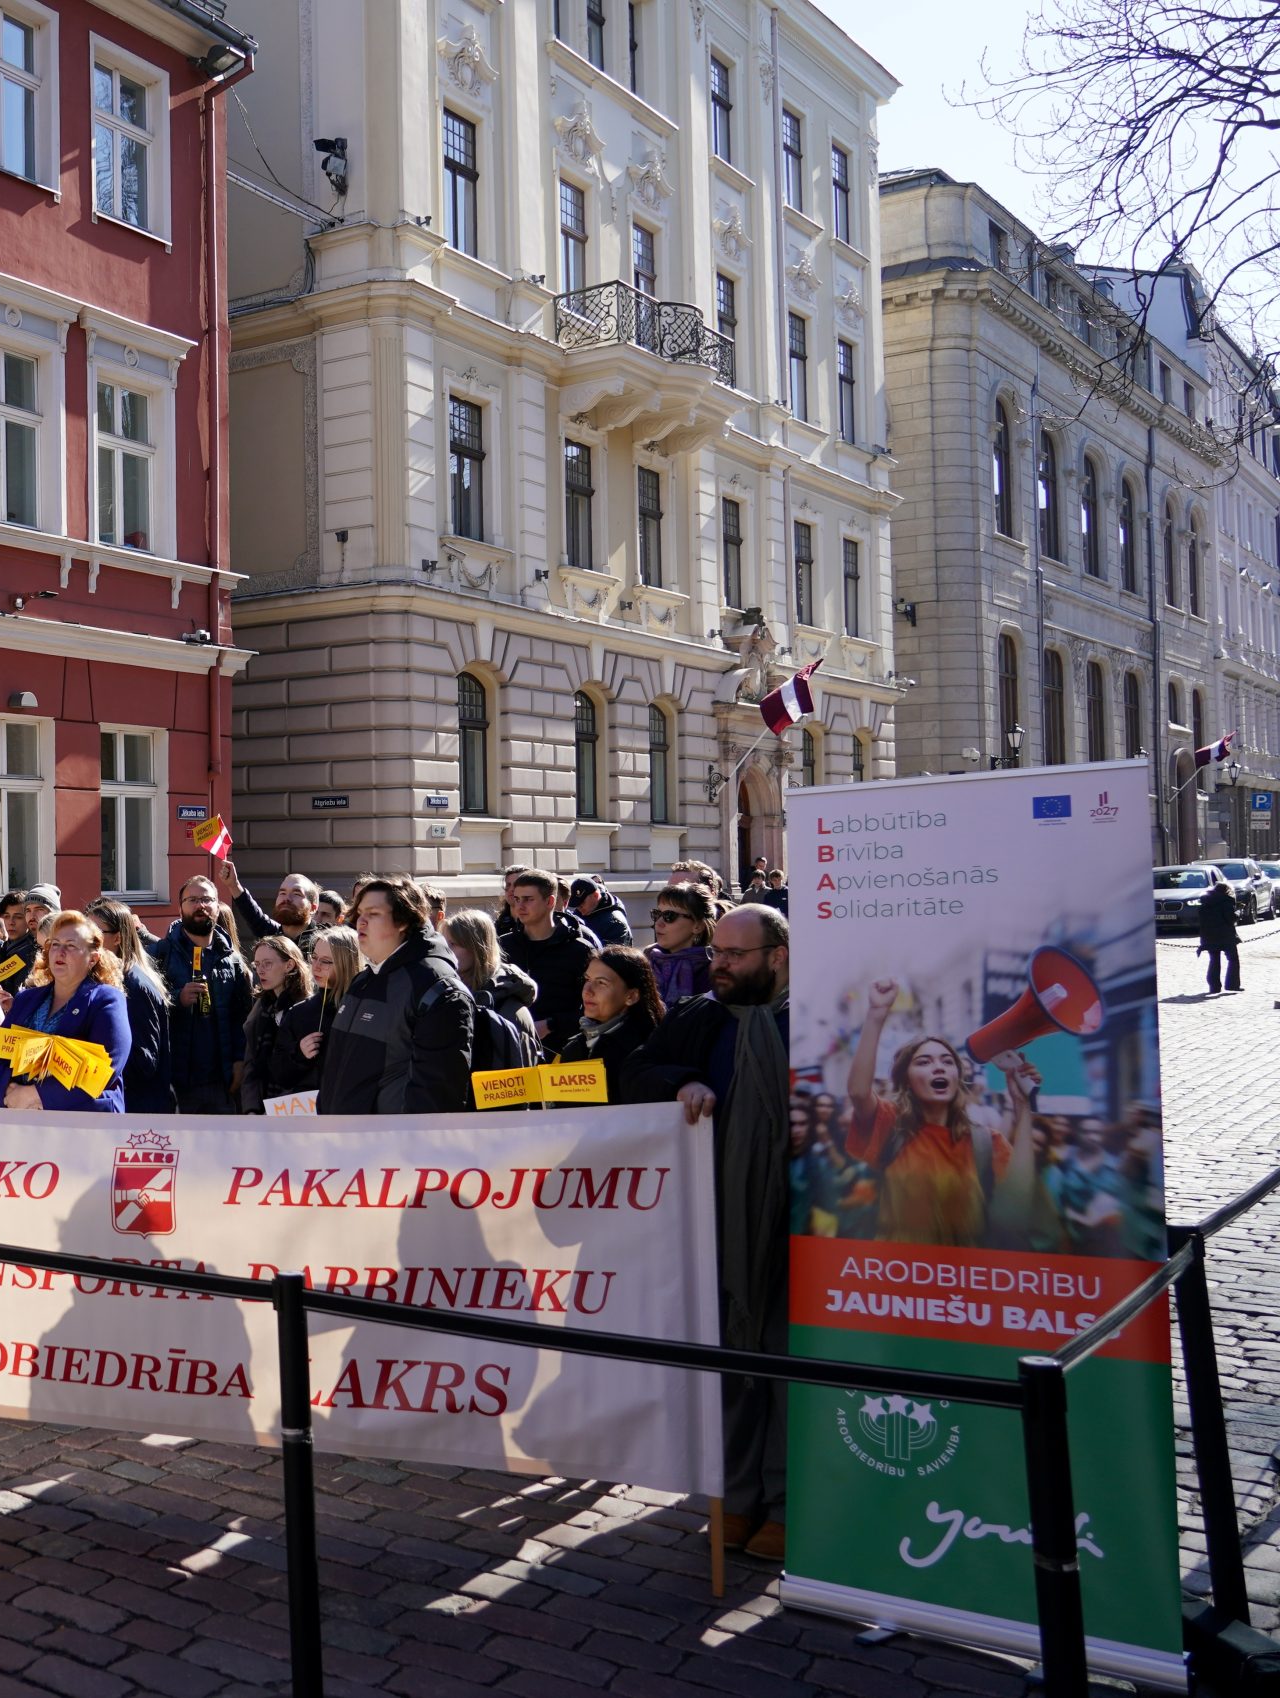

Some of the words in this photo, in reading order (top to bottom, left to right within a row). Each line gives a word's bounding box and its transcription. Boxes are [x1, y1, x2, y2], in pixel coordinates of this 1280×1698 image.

[181, 808, 197, 817] Jēkaba
[196, 809, 206, 817] iela
[817, 810, 947, 834] Labbūtība
[1090, 806, 1119, 817] 2027
[817, 841, 904, 862] Brīvība
[816, 865, 999, 894] Apvienošanās
[816, 897, 964, 920] Solidaritāte
[53, 1052, 73, 1075] LAKRS
[481, 1075, 525, 1091] VIENOTI
[550, 1074, 597, 1087] LAKRS
[484, 1088, 527, 1101] PRASĪBĀS!
[118, 1151, 175, 1164] LAKRS
[223, 1166, 671, 1211] PAKALPOJUMU
[840, 1256, 1101, 1300] ARODBIEDRĪBU
[825, 1289, 991, 1327] JAUNIEŠU
[1003, 1305, 1121, 1340] BALS
[310, 1358, 511, 1417] AKRS
[836, 1407, 906, 1478] ARODBIEDRĪBU
[917, 1425, 961, 1477] SAVIENĪBA
